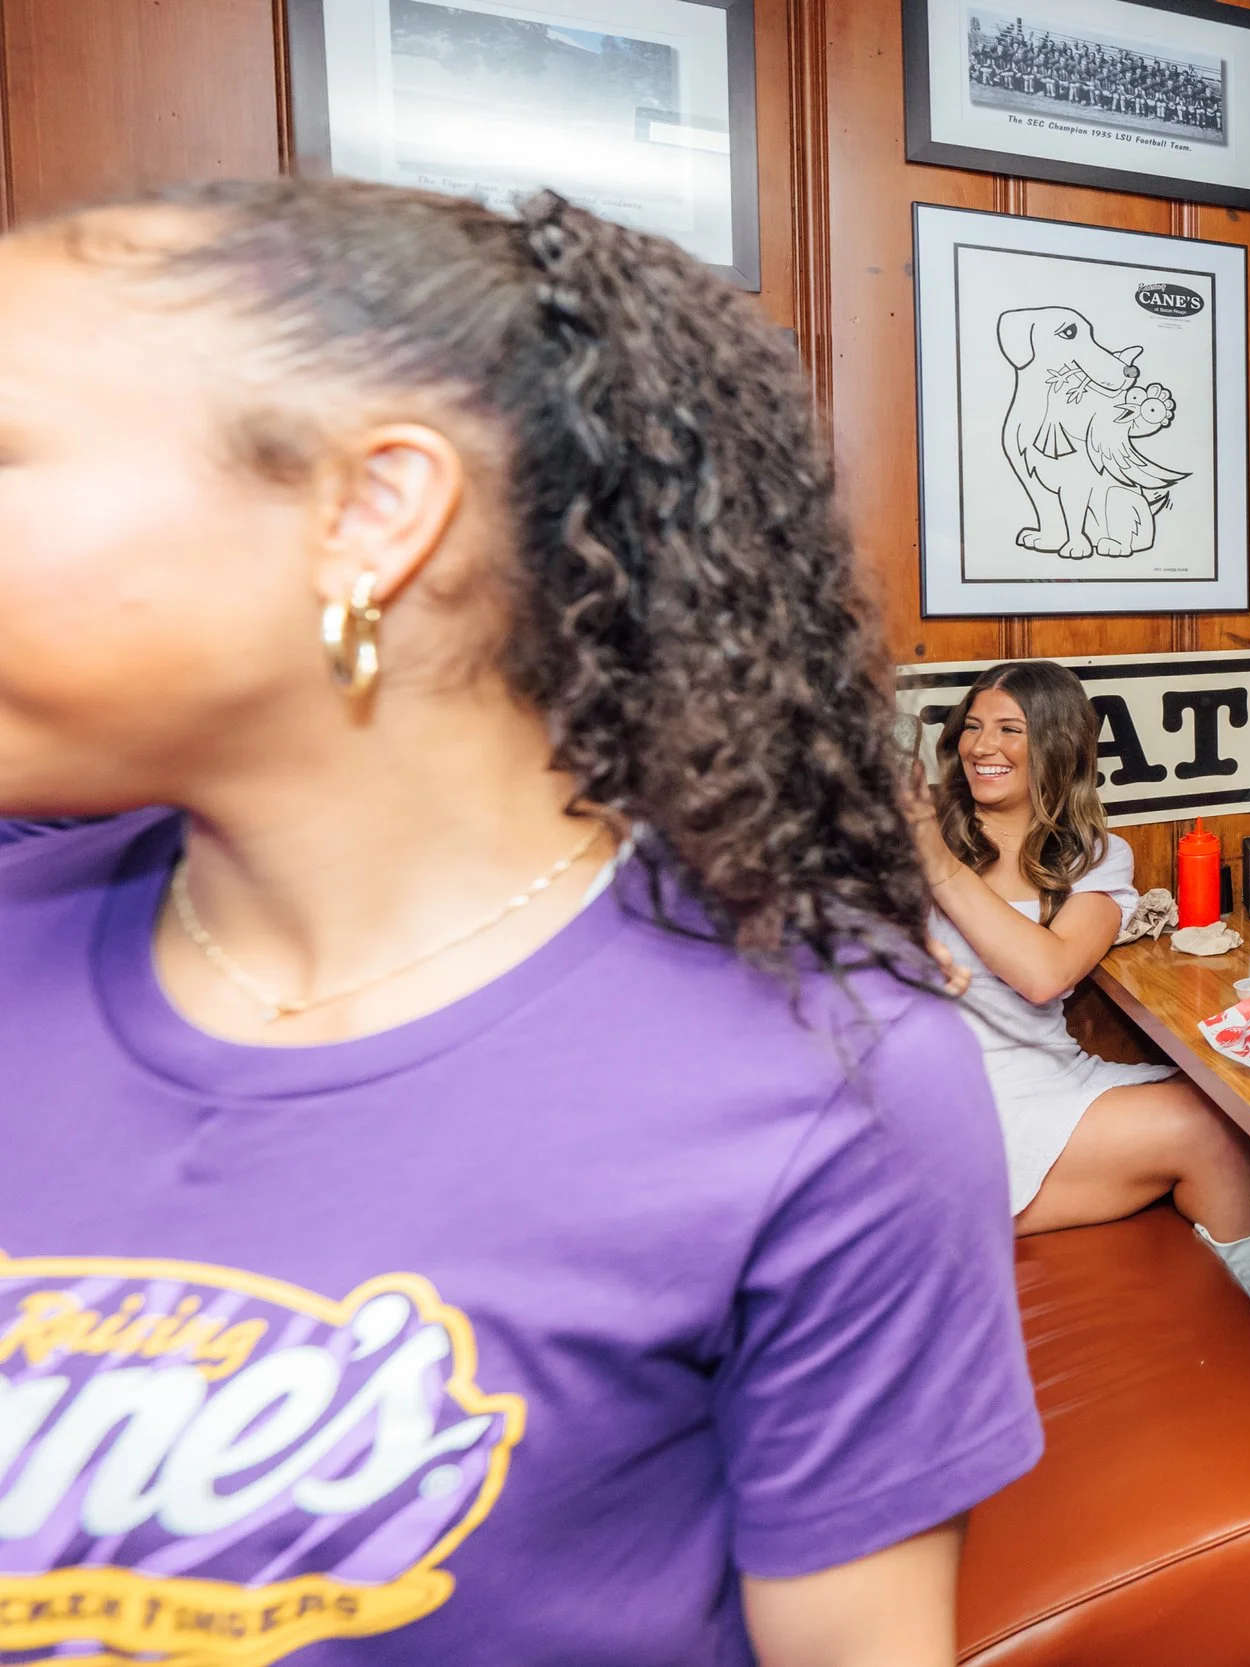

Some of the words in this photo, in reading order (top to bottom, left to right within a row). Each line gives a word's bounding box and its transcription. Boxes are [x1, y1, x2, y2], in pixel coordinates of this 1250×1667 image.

[1008, 115, 1023, 124] The
[1026, 118, 1045, 128] SEC
[1048, 122, 1088, 135] Champion
[1091, 129, 1112, 138] 1935
[1115, 133, 1132, 142] LSU
[1135, 136, 1167, 148] Football
[1170, 141, 1192, 152] Team.
[1139, 292, 1201, 309] CANE'S
